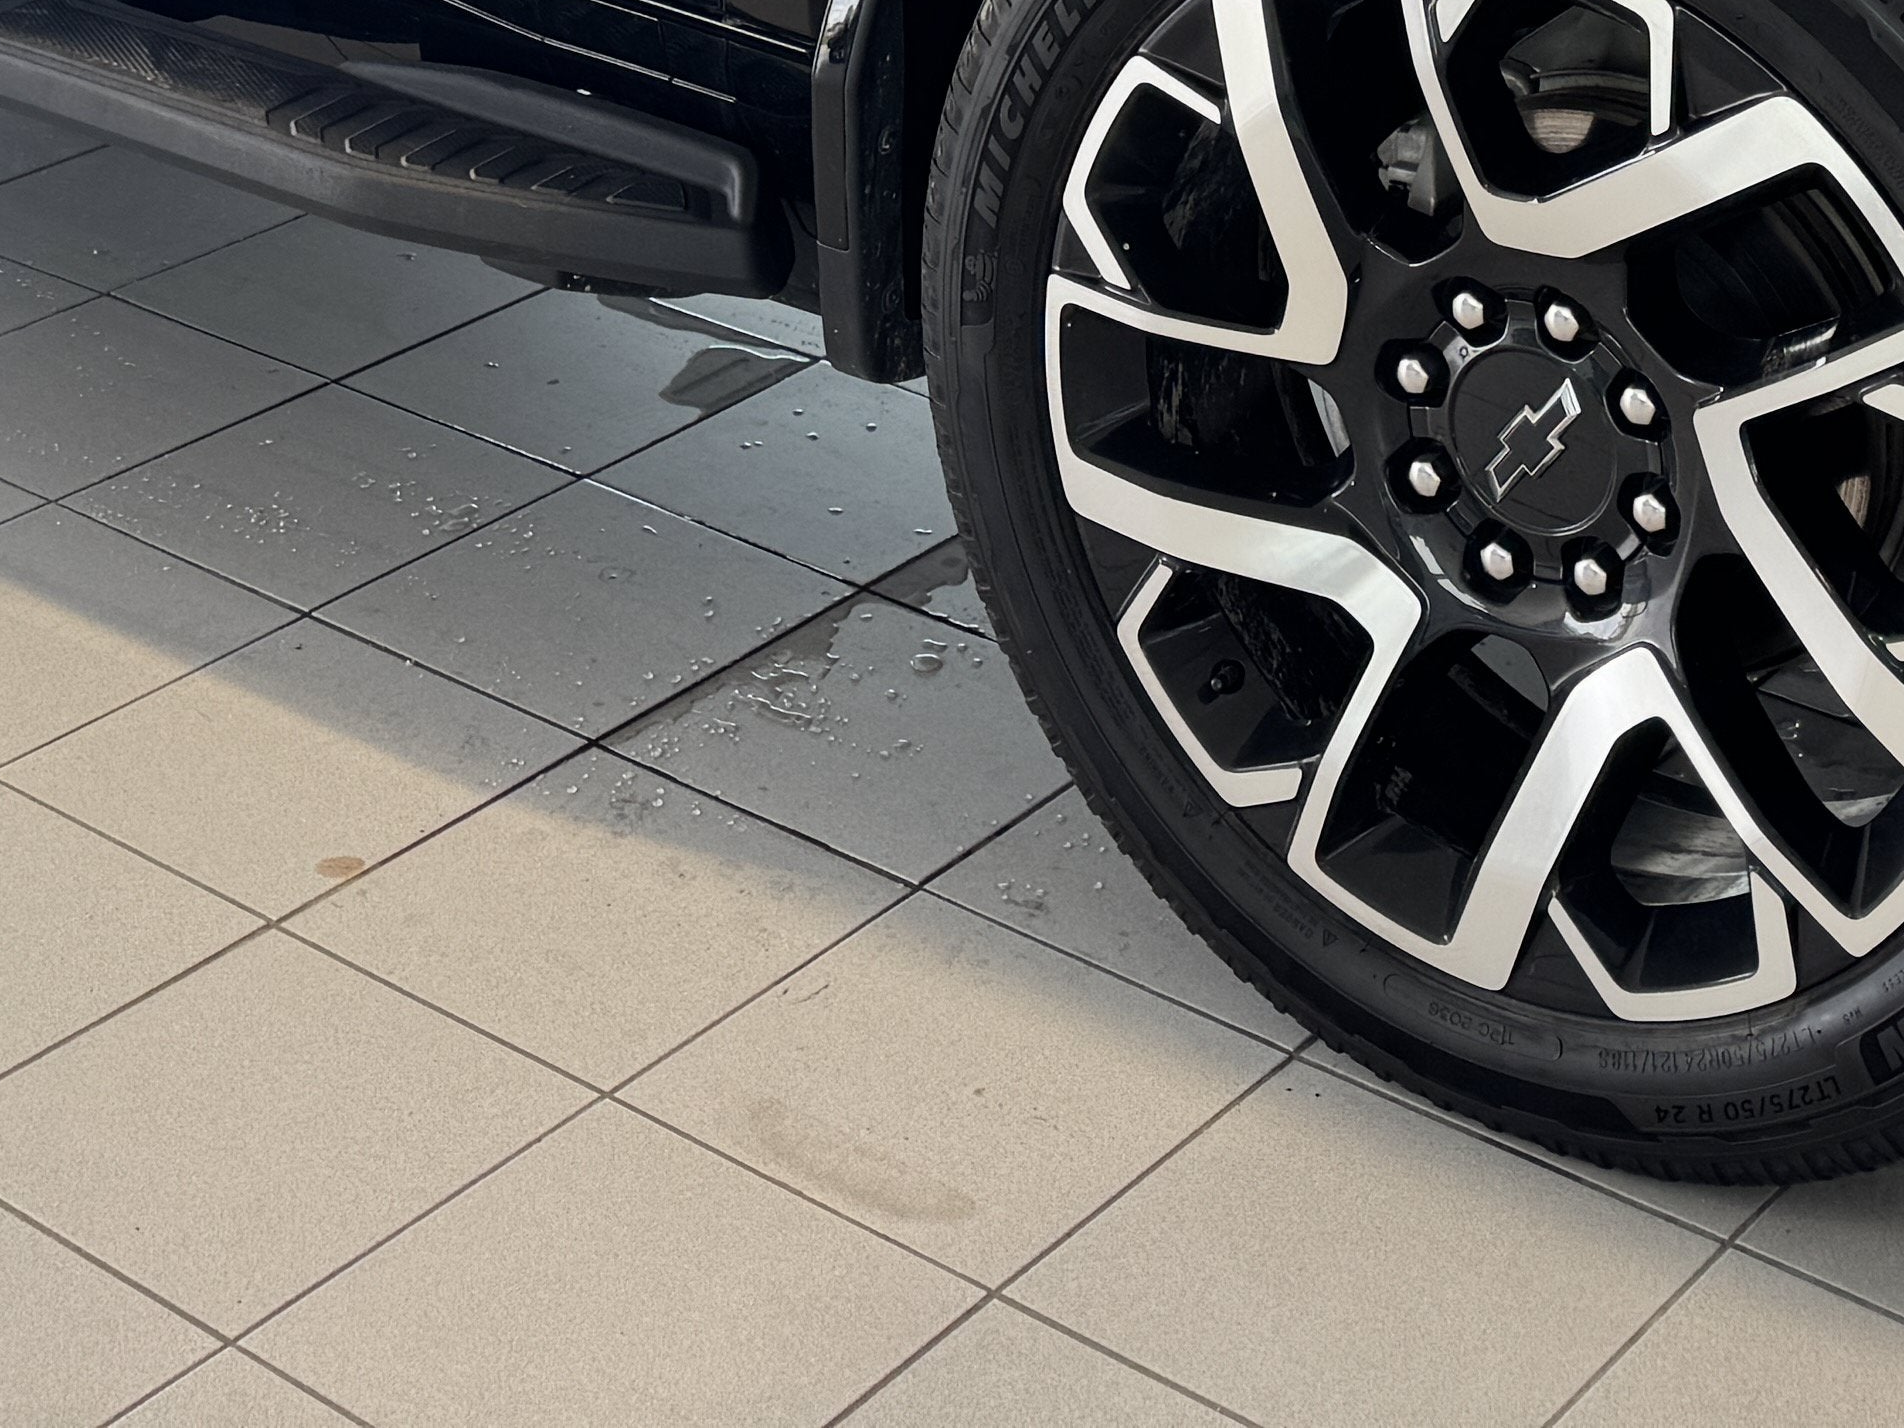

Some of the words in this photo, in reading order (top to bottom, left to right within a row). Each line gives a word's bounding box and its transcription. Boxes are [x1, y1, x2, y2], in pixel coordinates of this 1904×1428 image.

[1724, 1075, 1843, 1120] LT275/50
[1654, 1104, 1686, 1125] 24
[1696, 1105, 1715, 1124] R
